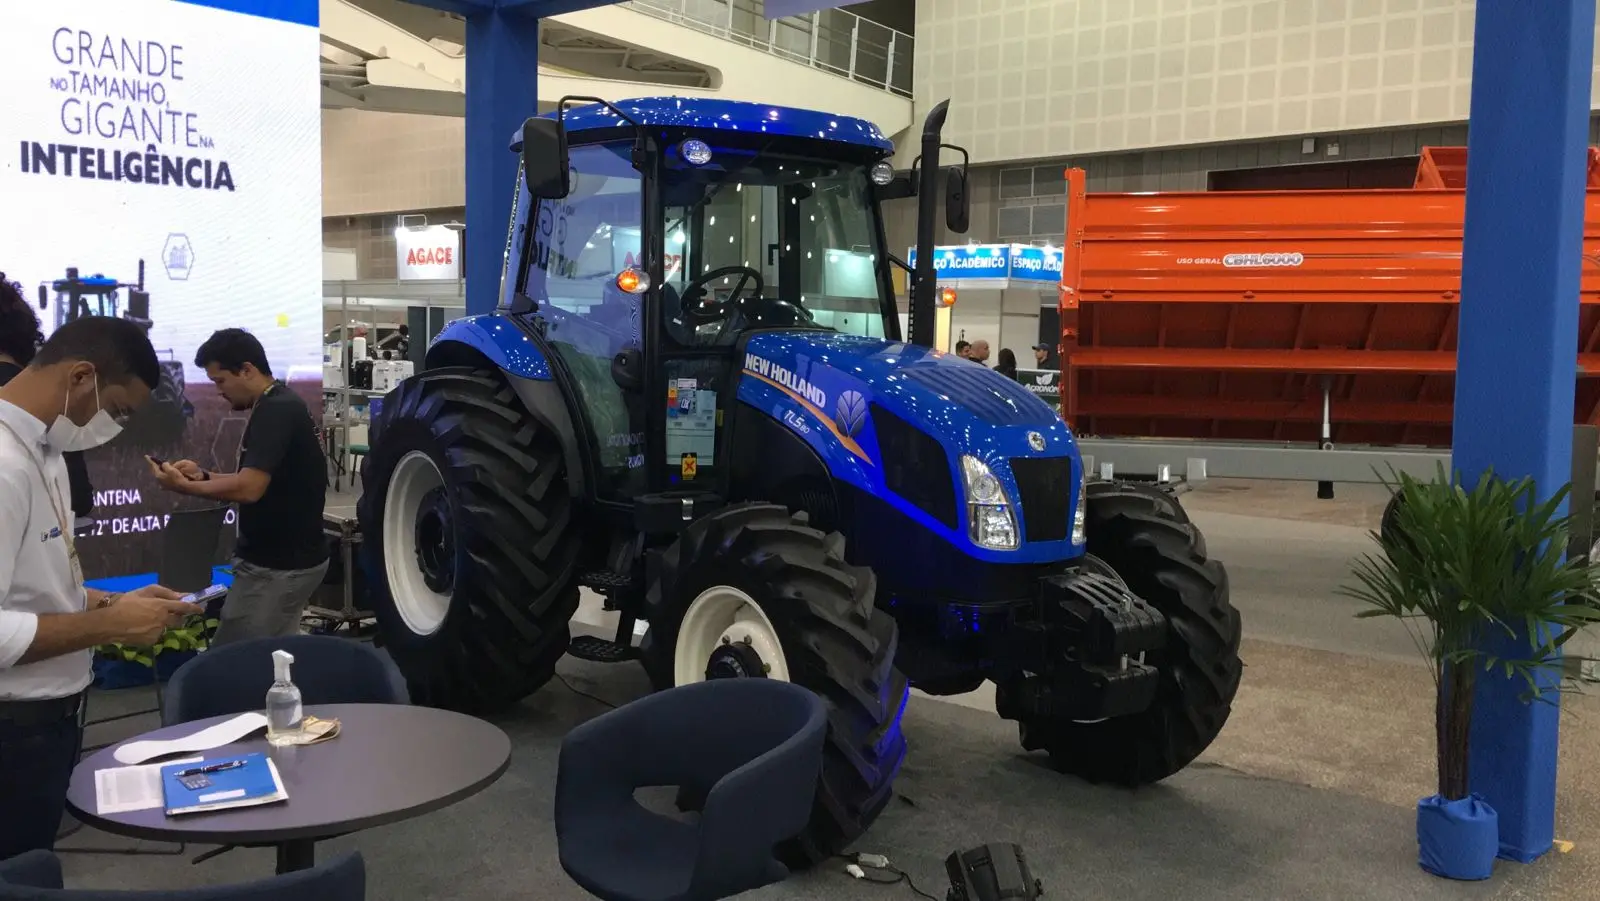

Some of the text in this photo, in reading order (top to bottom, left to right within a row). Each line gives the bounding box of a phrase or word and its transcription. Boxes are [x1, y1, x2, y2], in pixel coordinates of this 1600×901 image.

[52, 27, 184, 80] GRANDE
[50, 70, 169, 109] NO TAMANHO,
[61, 97, 215, 149] GIGANTE NA
[20, 141, 236, 191] INTELIGÊNCIA
[406, 246, 453, 266] AGACE
[949, 255, 1005, 269] ACADÊMICO
[1013, 257, 1041, 272] ESPAÇO
[1176, 253, 1302, 267] USO GERAL CBHL6000
[745, 353, 826, 408] NEW HOLLAND
[91, 519, 109, 536] 2"
[112, 517, 130, 535] DE
[131, 513, 161, 533] ALTA
